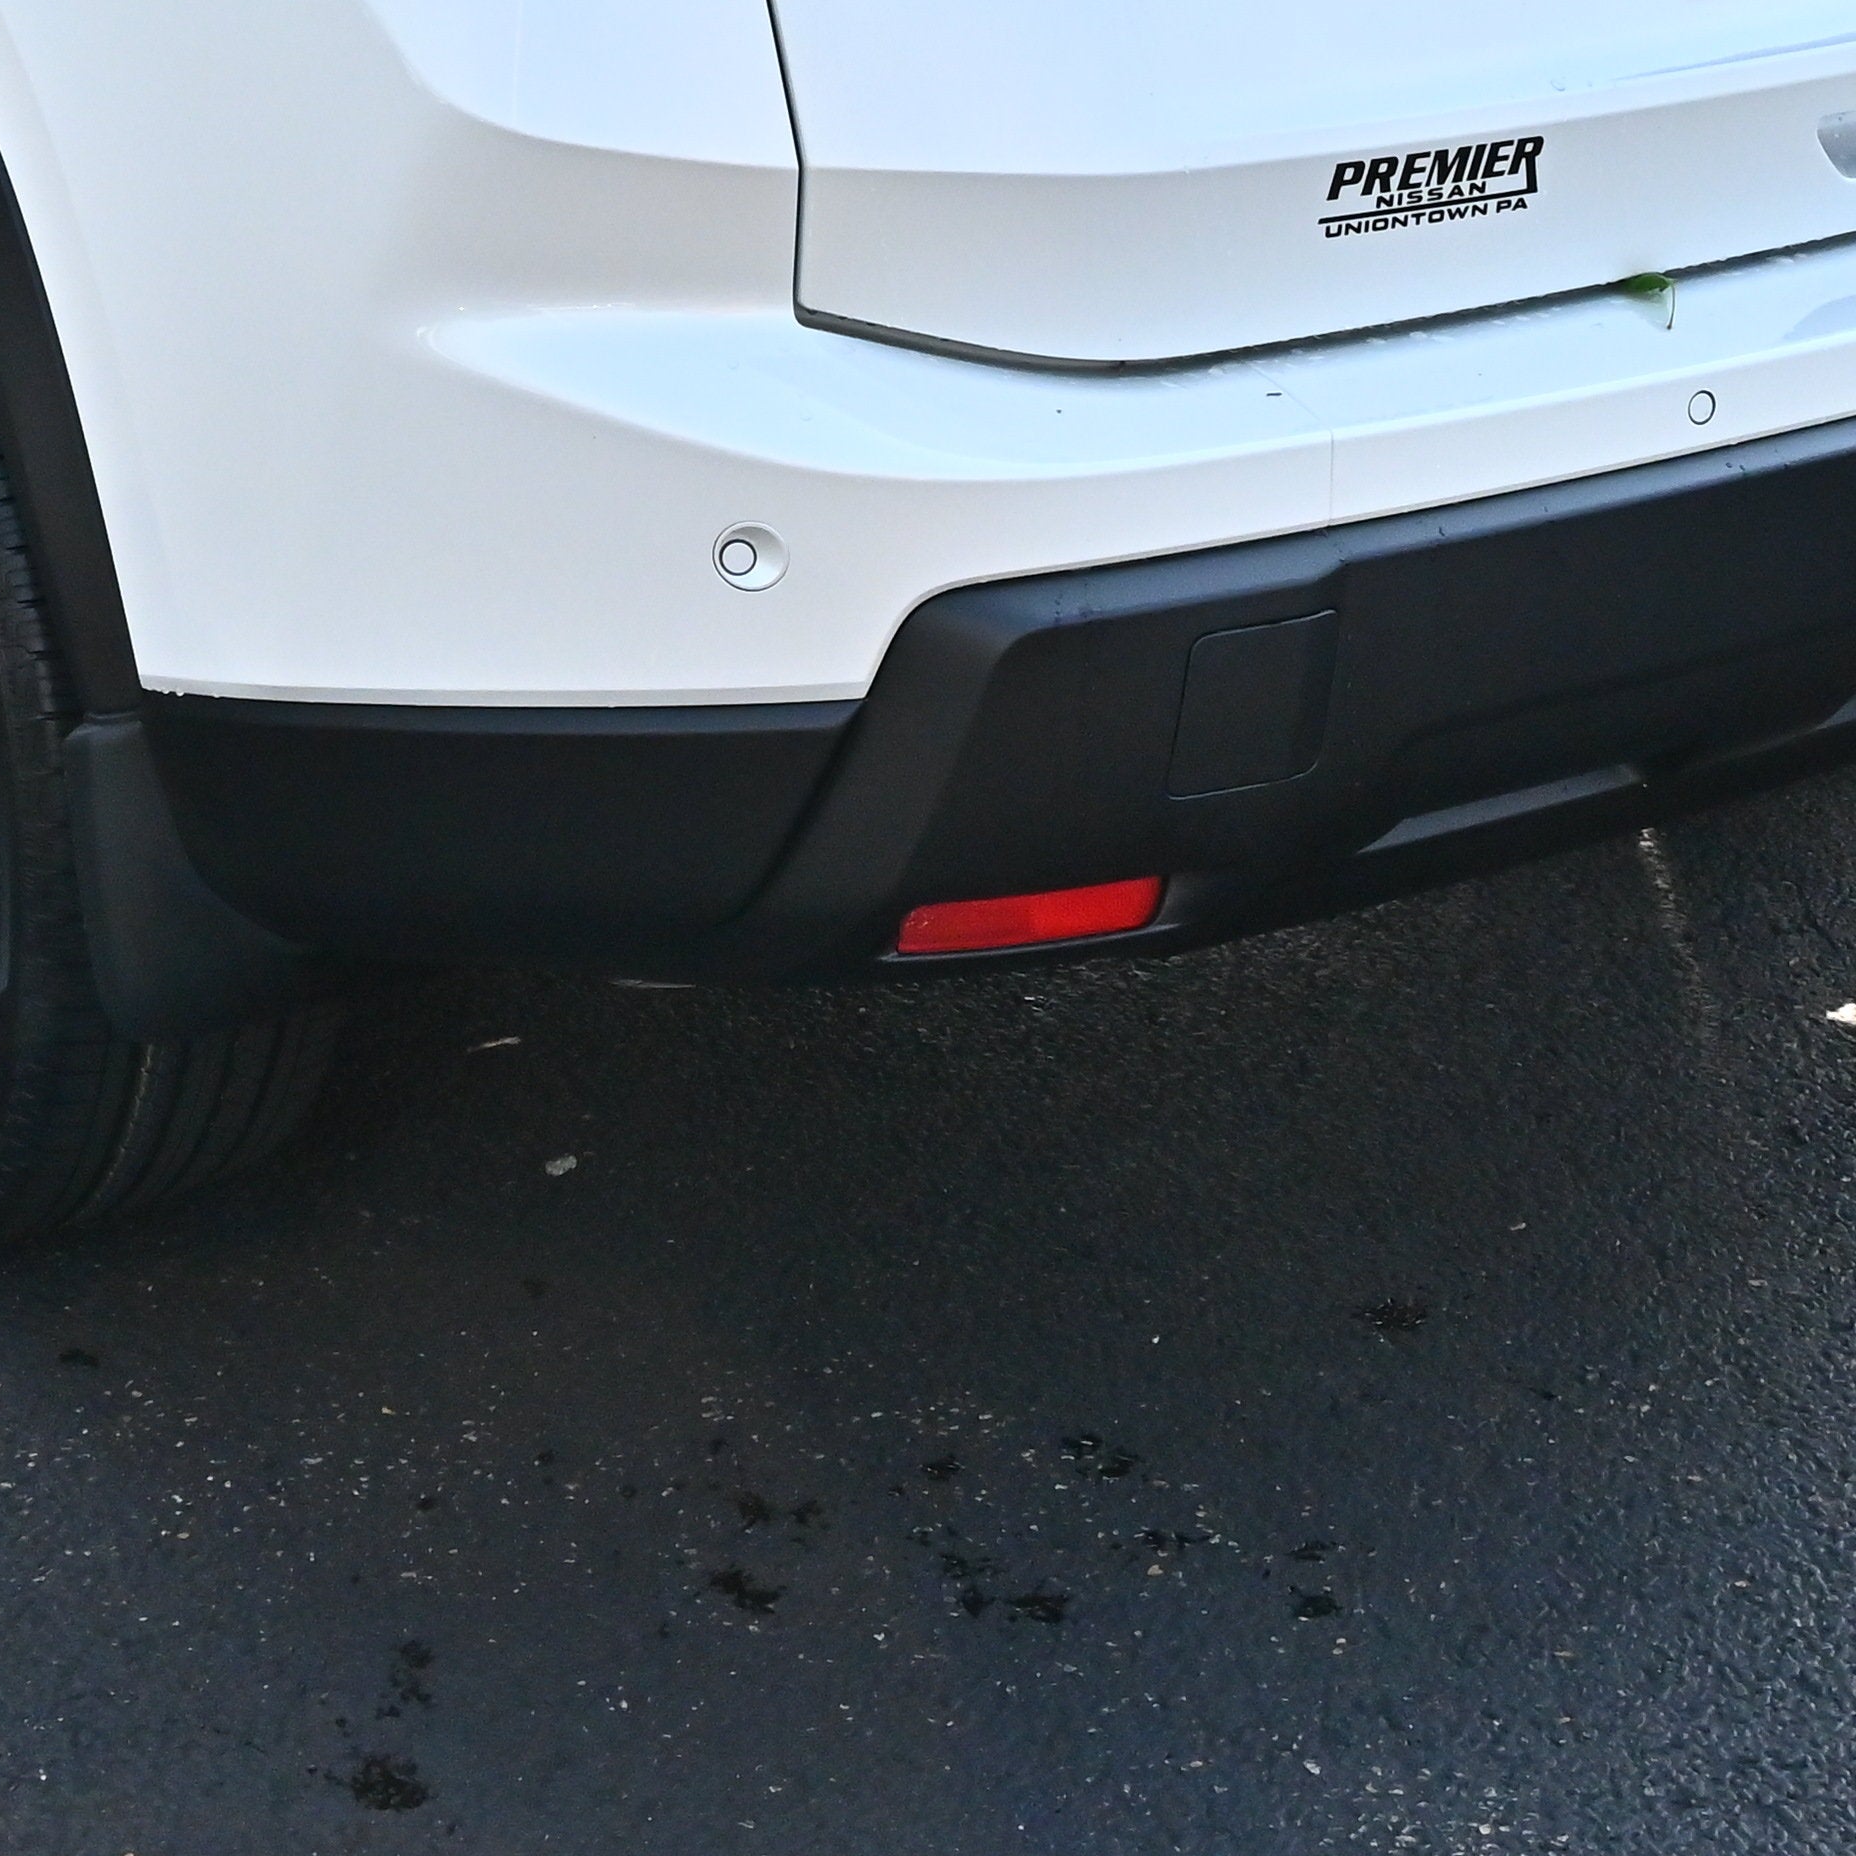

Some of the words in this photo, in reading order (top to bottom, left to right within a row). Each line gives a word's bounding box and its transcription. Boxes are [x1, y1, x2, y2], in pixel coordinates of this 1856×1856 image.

[1326, 135, 1544, 201] PREMIER
[1375, 181, 1487, 209] NISSAN
[1324, 201, 1488, 238] UNIONTOWN
[1495, 196, 1528, 214] PA
